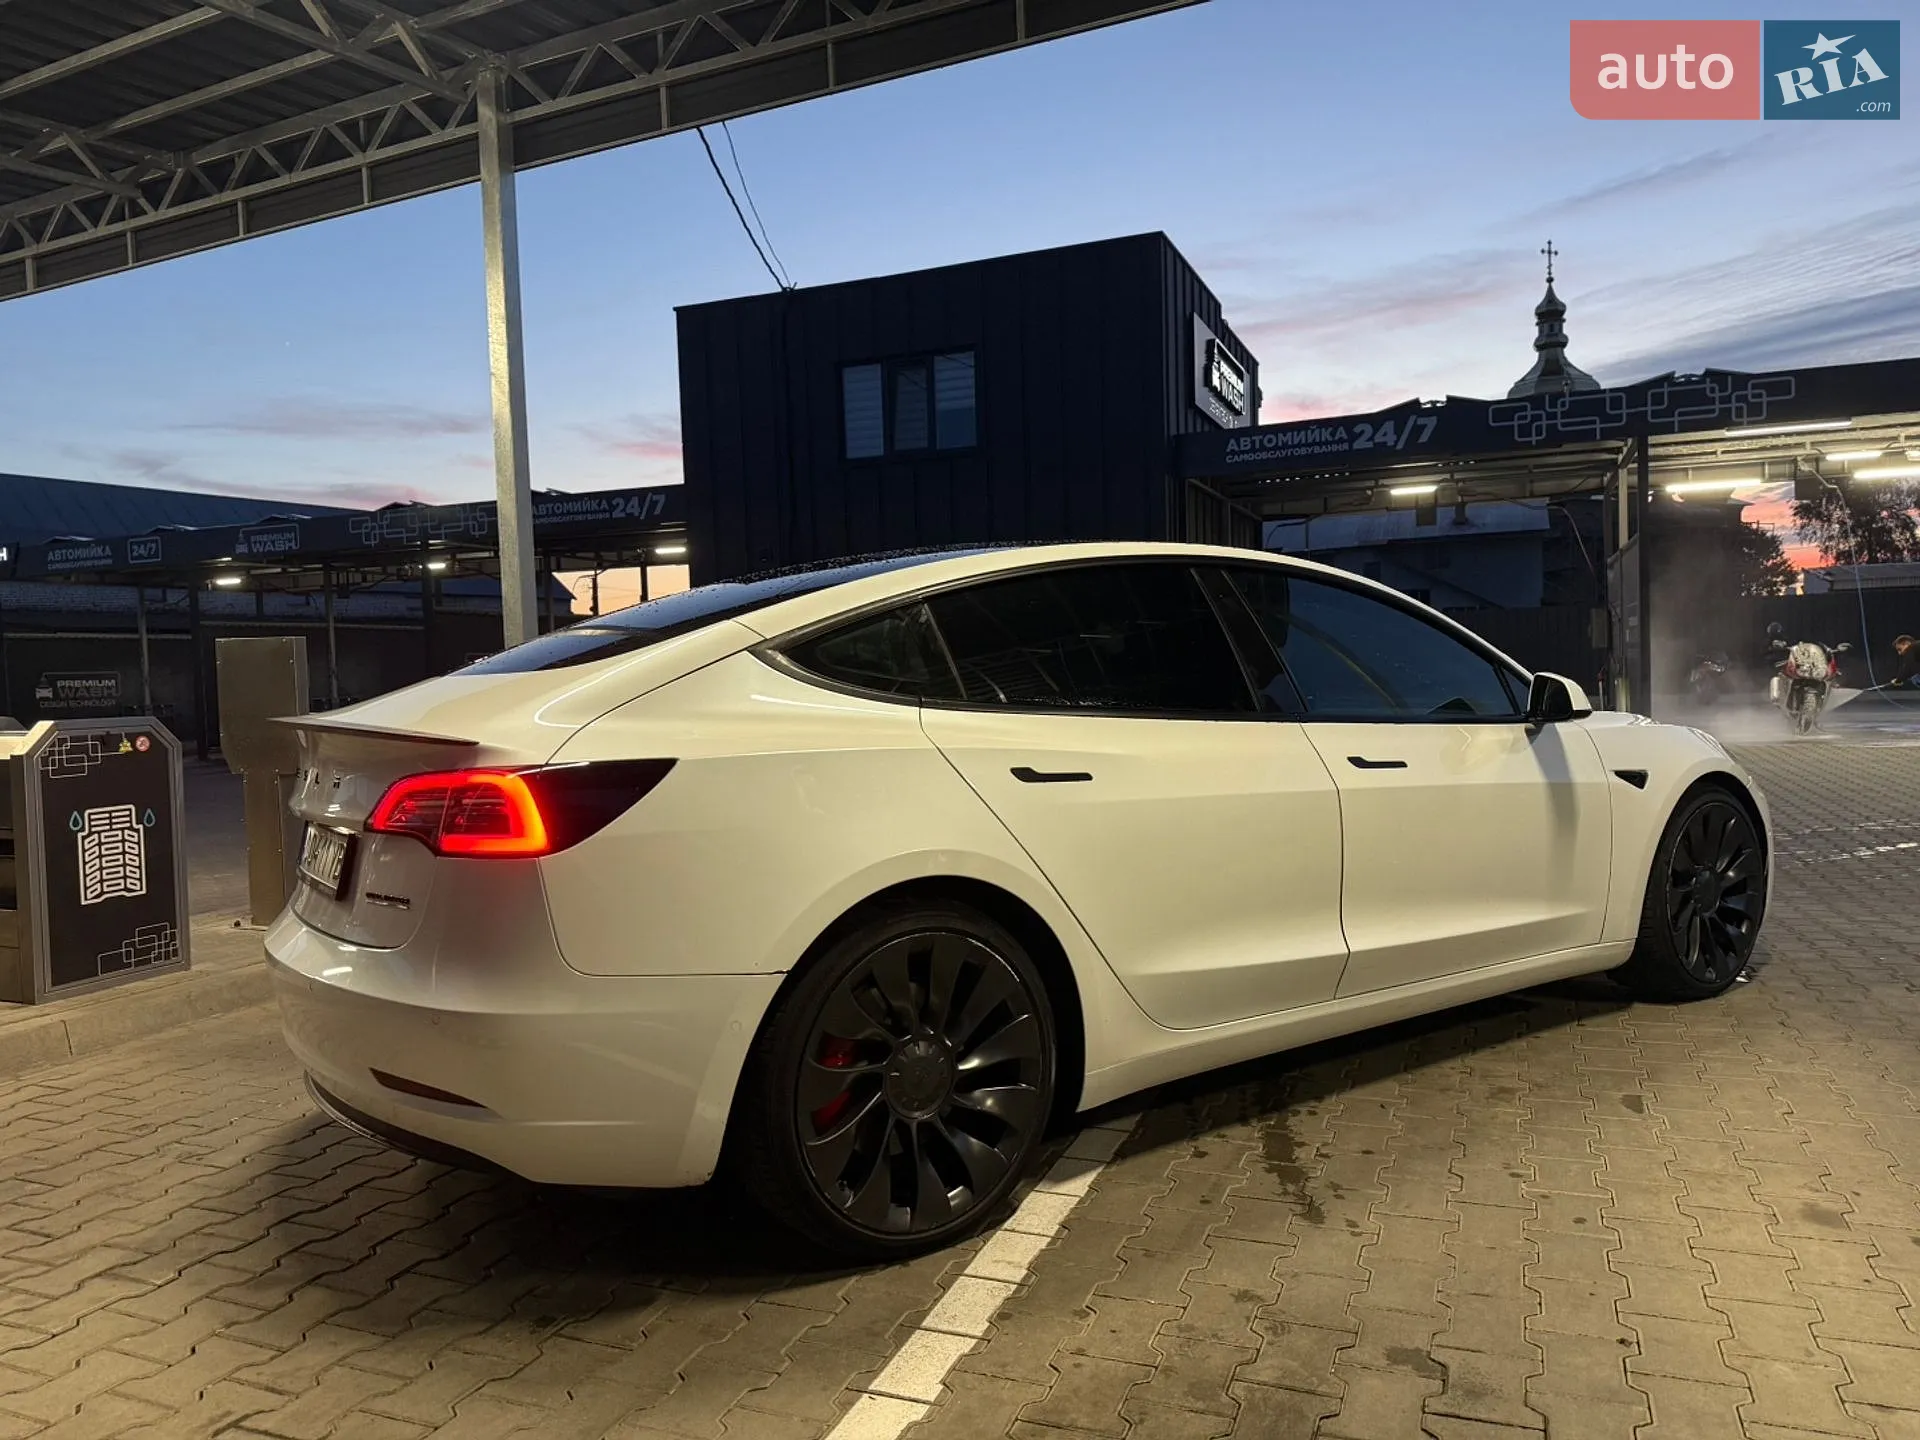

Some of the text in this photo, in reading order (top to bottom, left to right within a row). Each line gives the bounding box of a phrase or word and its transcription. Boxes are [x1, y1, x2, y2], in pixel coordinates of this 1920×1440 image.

[1226, 415, 1439, 452] АВТОМИЙКА 24/7
[1225, 442, 1350, 463] САМООБСЛУГОВУВАННЯ
[611, 492, 666, 520] 24/7
[47, 543, 157, 562] АВТОМИЙКА 24/7
[251, 540, 295, 553] WASH
[56, 679, 116, 688] PREMIUM
[59, 687, 116, 699] WASH
